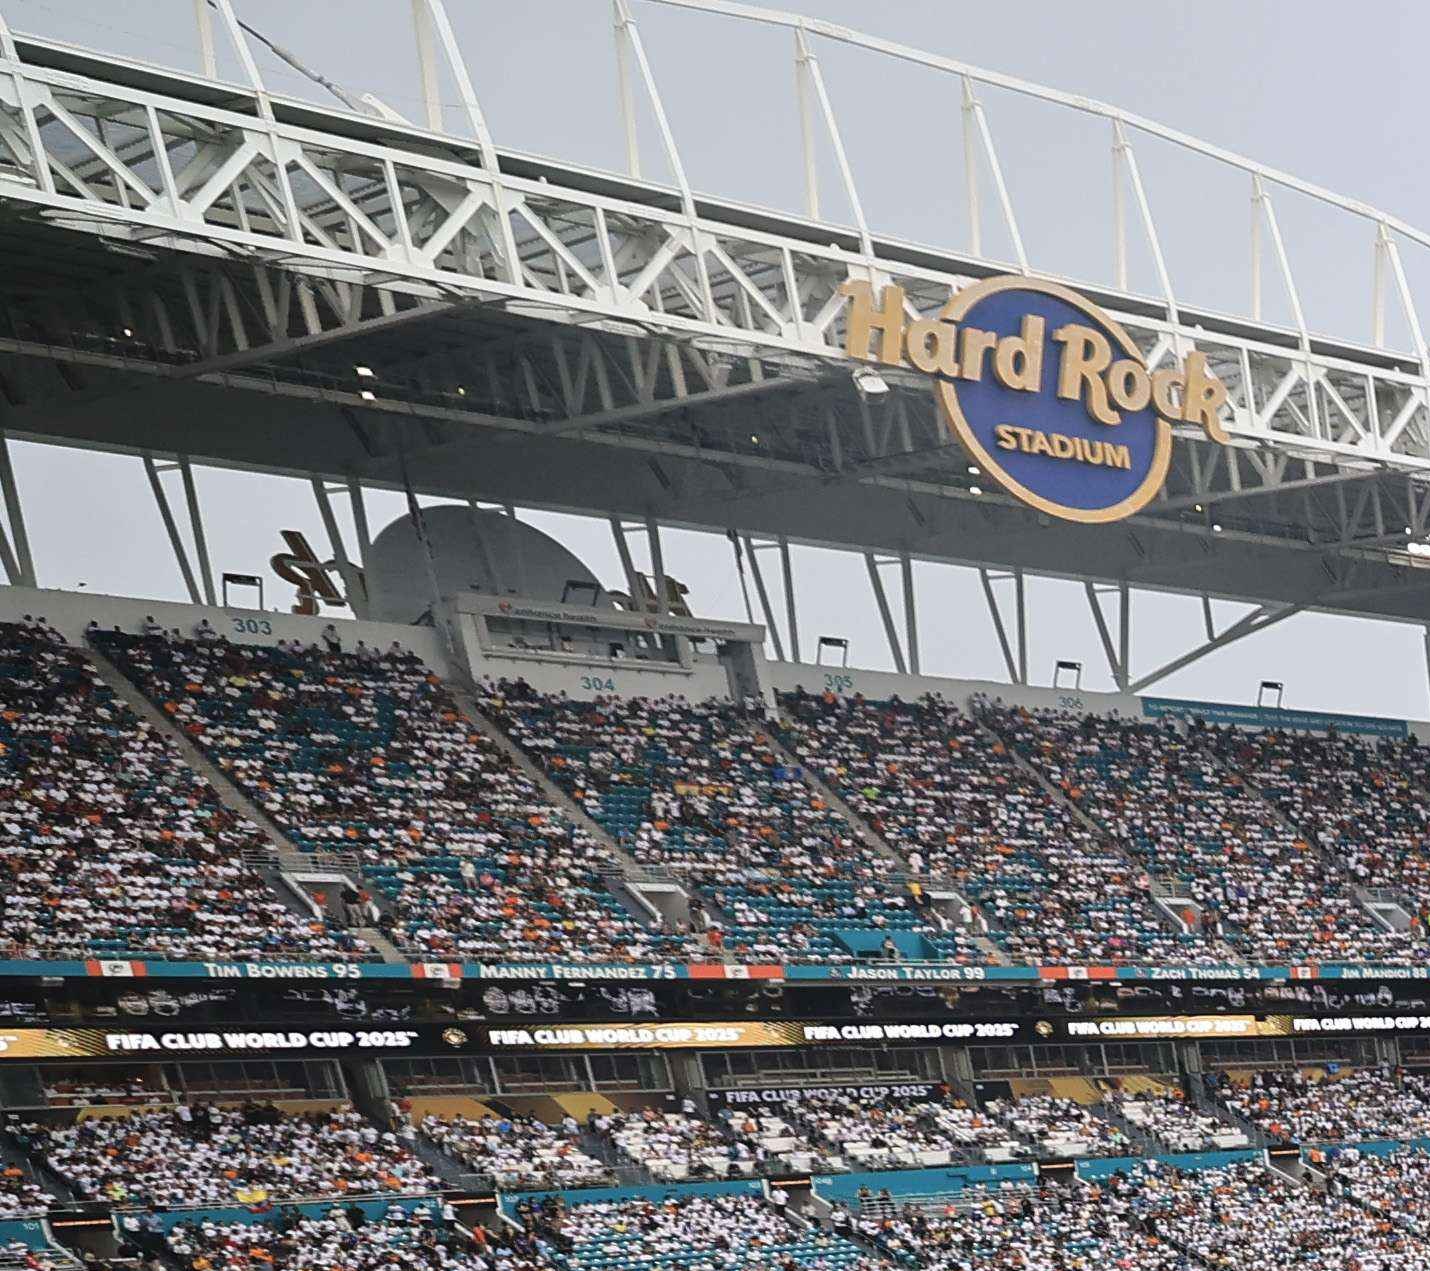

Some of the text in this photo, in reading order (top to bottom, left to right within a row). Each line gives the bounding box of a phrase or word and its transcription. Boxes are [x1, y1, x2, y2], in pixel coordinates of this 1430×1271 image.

[839, 280, 1230, 446] Hard Rock
[993, 423, 1132, 470] STADIUM
[232, 619, 272, 634] 303
[582, 677, 615, 690] 304
[246, 963, 328, 978] BOWENS
[332, 963, 362, 978] 95
[480, 963, 677, 979] MANNY FERNANDEZ 75
[848, 966, 986, 979] JASON TAYLOR 99
[1188, 967, 1241, 979] THOMAS
[1244, 967, 1260, 979] 54
[803, 1025, 841, 1039] FIFA
[842, 1024, 884, 1039] CLUB
[884, 1023, 941, 1038] WORLD
[942, 1023, 974, 1038] CUP
[104, 1033, 162, 1050] FIFA
[161, 1033, 222, 1050] CLUB
[222, 1032, 308, 1049] WORLD
[309, 1031, 355, 1047] CUP
